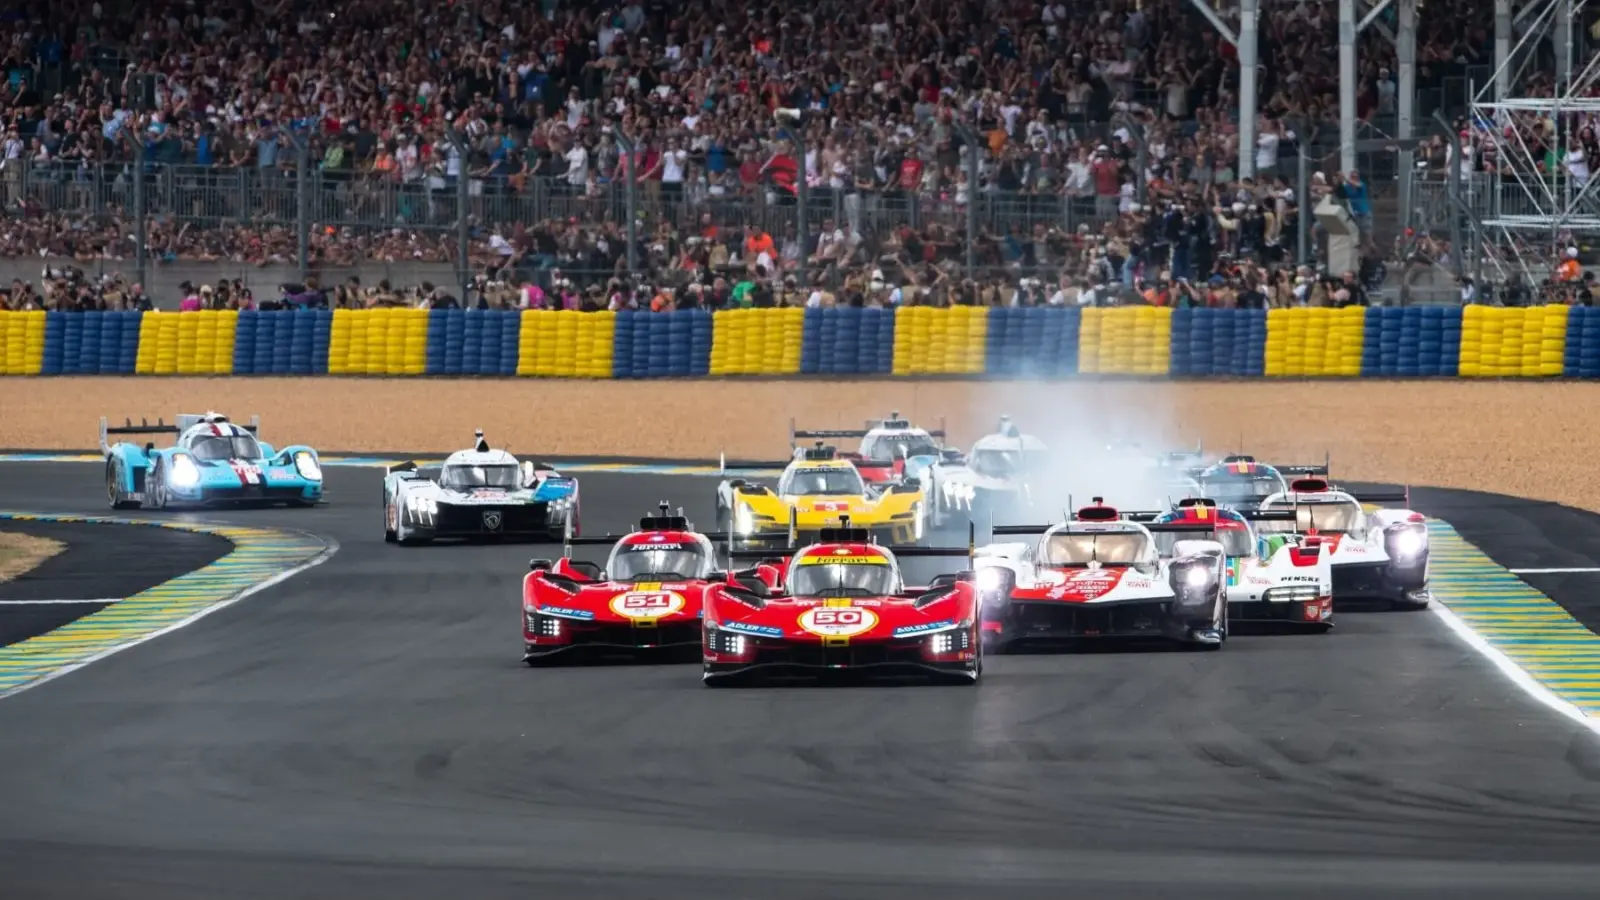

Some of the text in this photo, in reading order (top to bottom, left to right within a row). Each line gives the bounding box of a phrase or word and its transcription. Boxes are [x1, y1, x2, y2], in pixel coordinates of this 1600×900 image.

[631, 543, 682, 551] Ferrari
[1280, 575, 1320, 583] PENSKE
[626, 595, 668, 607] 51
[542, 606, 573, 615] ADLER
[815, 612, 860, 624] 50
[726, 622, 760, 631] ADLER
[897, 624, 928, 634] ADLER
